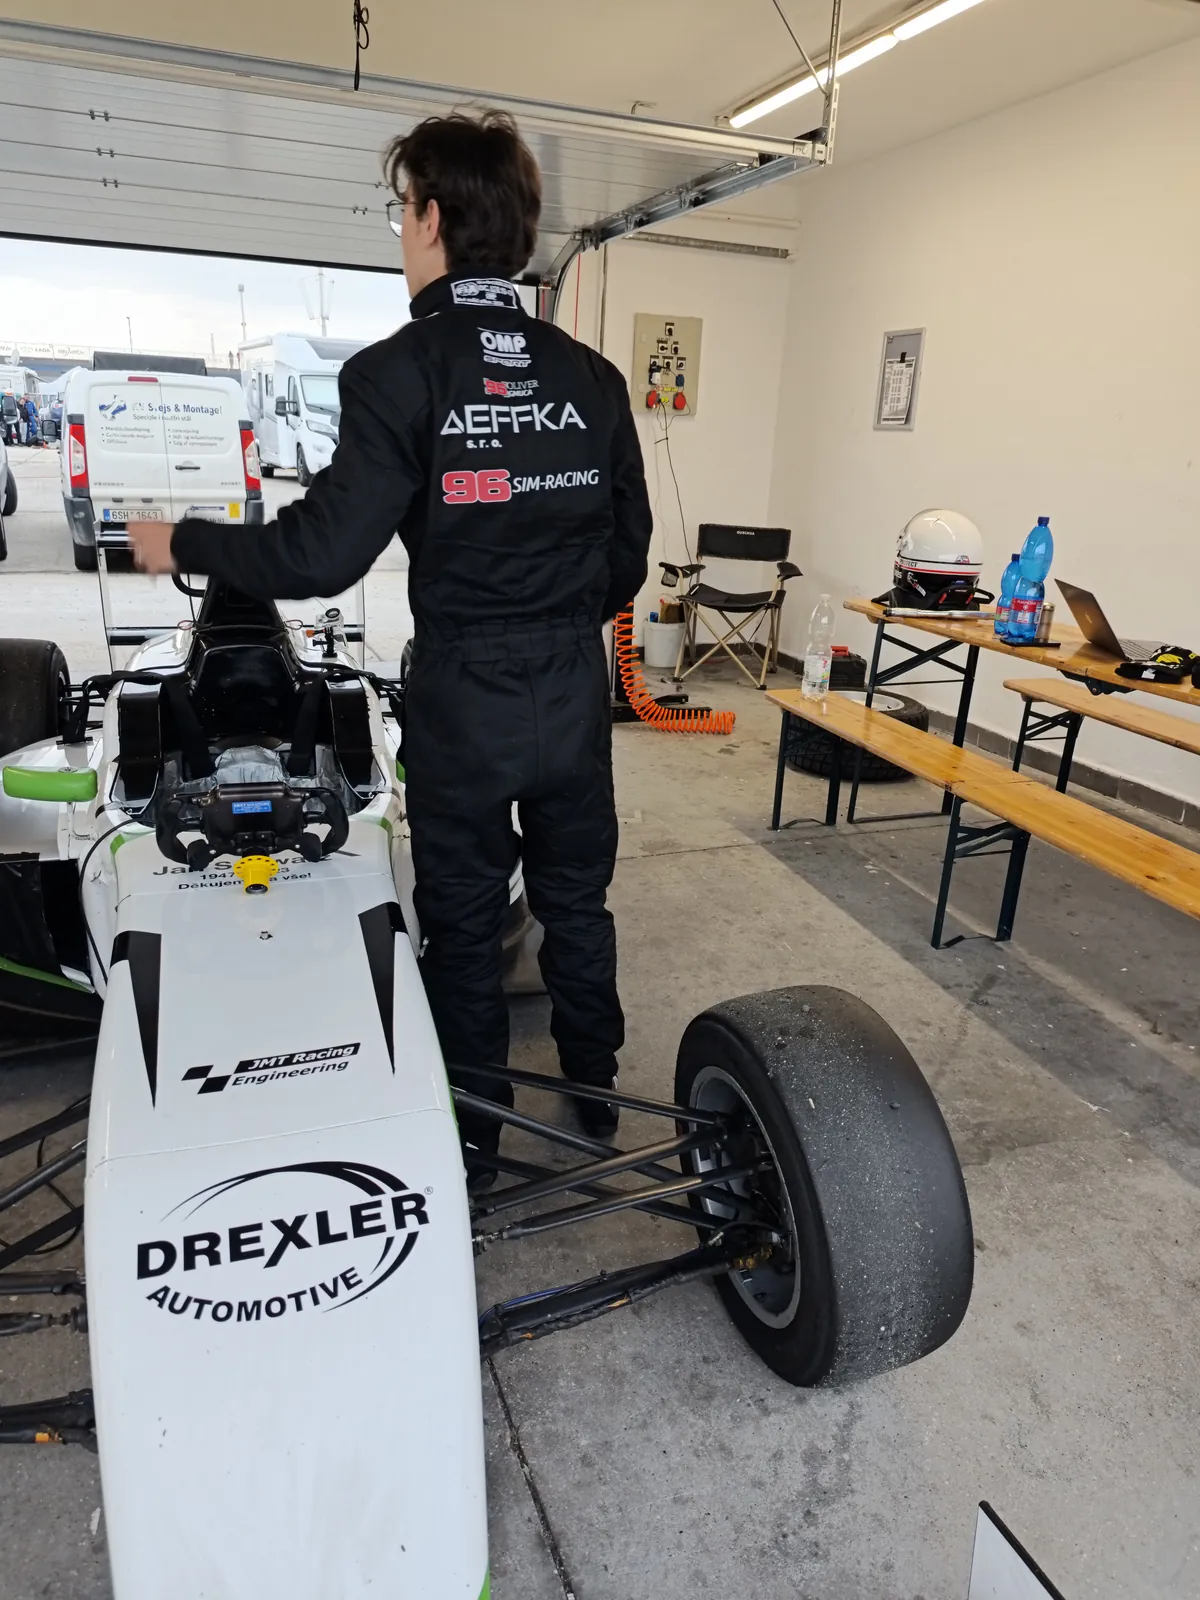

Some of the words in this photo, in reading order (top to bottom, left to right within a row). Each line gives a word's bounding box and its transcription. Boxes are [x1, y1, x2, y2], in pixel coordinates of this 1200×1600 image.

[480, 331, 526, 353] OMP
[506, 380, 539, 390] OLIVER
[174, 403, 180, 412] &
[442, 469, 512, 504] 96
[512, 469, 599, 493] SIM-RACING
[112, 511, 129, 520] 6SH
[137, 511, 158, 520] 1643
[248, 1056, 289, 1070] JMT
[292, 1046, 355, 1063] Racing
[232, 1061, 350, 1087] Engineering
[137, 1193, 430, 1280] DREXLER
[146, 1266, 364, 1322] AUTOMOTIVE
